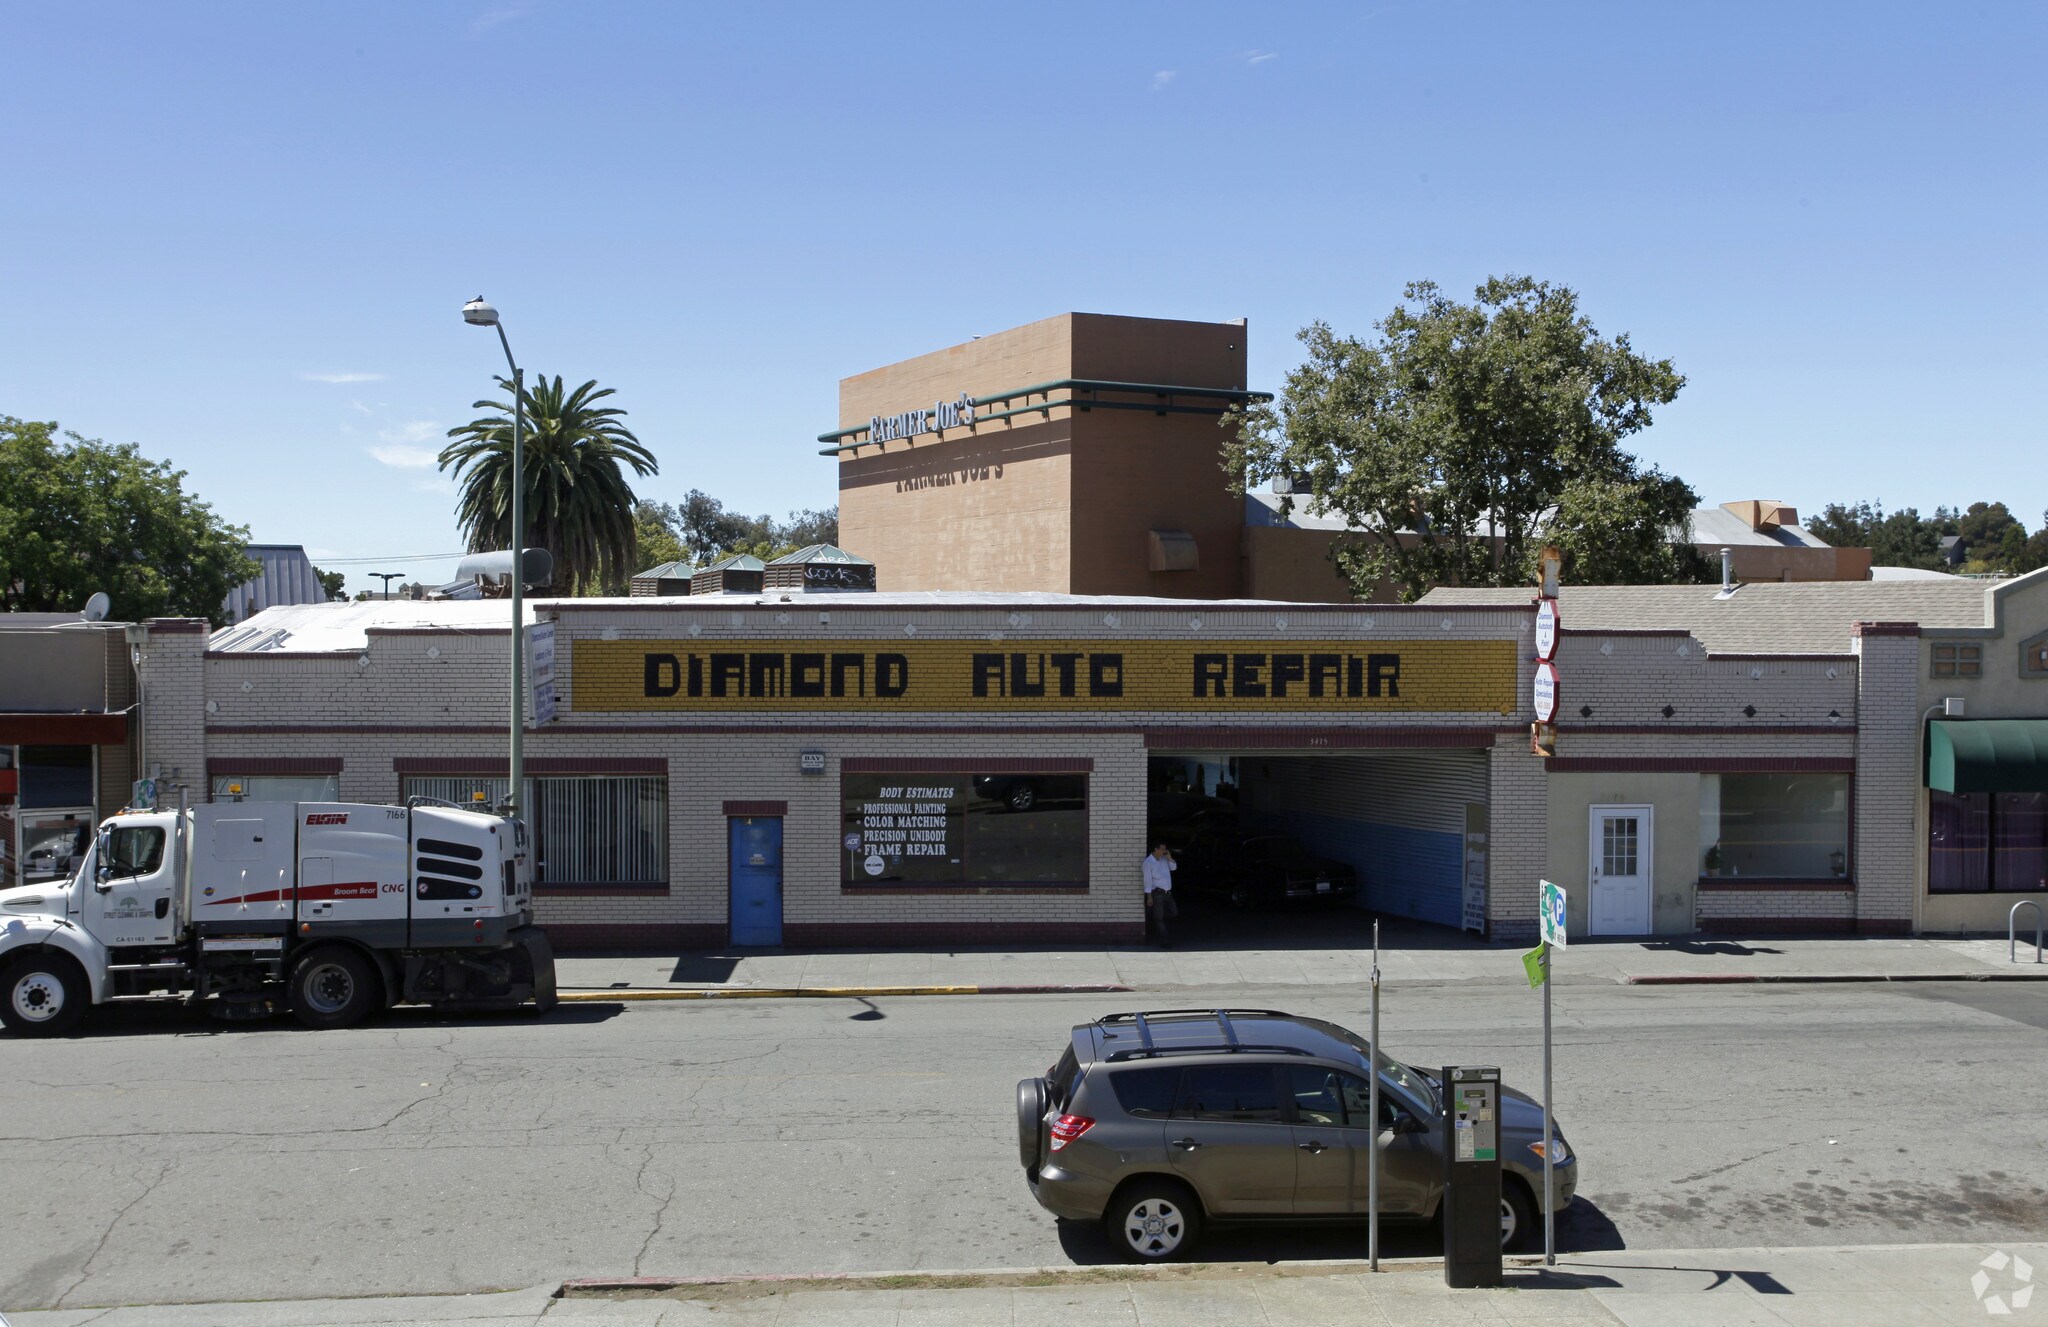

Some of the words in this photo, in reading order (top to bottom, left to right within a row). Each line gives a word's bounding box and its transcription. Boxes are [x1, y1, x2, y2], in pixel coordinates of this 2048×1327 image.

[869, 409, 928, 445] FARMER
[930, 391, 976, 431] JOE'S
[644, 653, 908, 697] DIAMOND
[972, 653, 1123, 697] AUTO
[1193, 653, 1400, 697] REPAIR
[879, 787, 903, 798] BODY
[906, 787, 954, 798] ESTIMATES
[863, 803, 912, 814] PROFESSIONAL
[914, 803, 946, 814] PAINTING
[305, 813, 350, 825] ELGIN
[386, 810, 405, 819] 7166
[863, 816, 894, 827] COLOR
[897, 816, 946, 828] MATCHING
[863, 830, 907, 841] PRECISION
[910, 830, 946, 841] UNIBODY
[864, 844, 902, 855] FRAME
[906, 844, 946, 855] REPAIR
[382, 884, 405, 893] CNG
